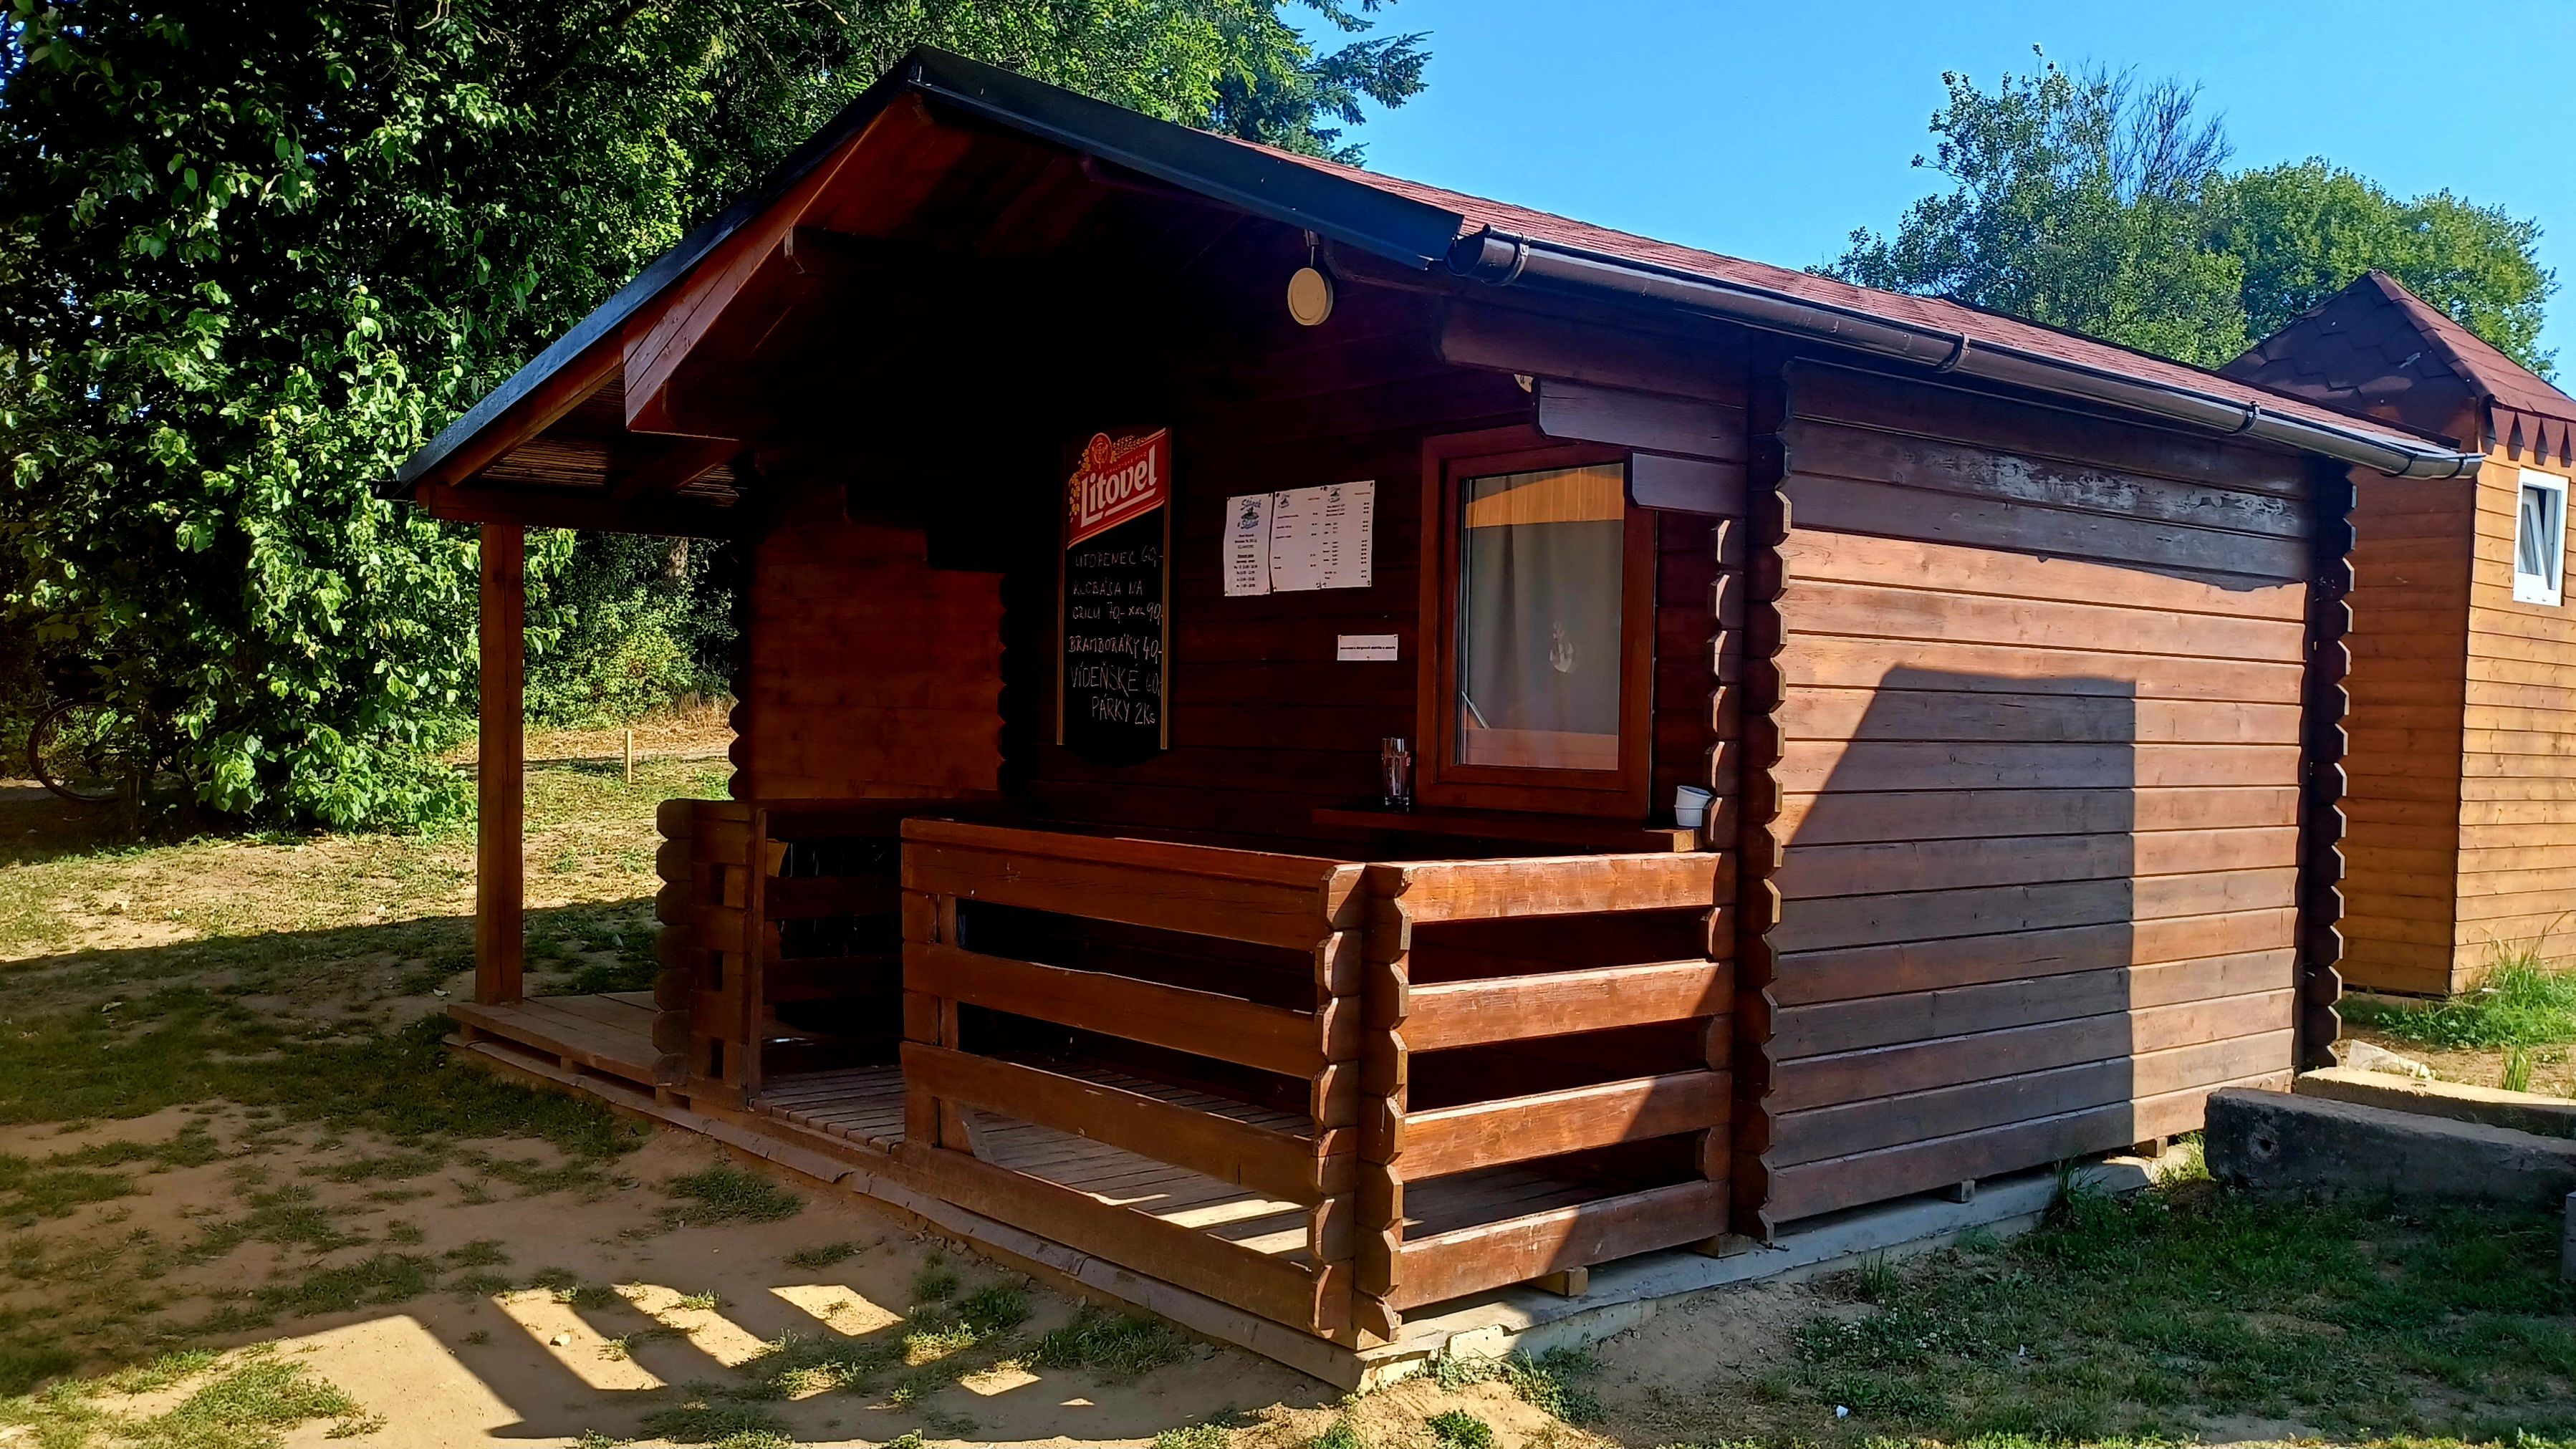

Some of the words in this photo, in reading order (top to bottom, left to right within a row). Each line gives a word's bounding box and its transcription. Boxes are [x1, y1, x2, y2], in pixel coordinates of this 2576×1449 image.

[1080, 444, 1158, 529] Litovel
[1075, 551, 1136, 568] UTOPENEC
[1128, 579, 1143, 596] NA
[1072, 606, 1101, 620] GRILU
[1068, 633, 1140, 659] BRAMBORÁKY
[1070, 660, 1139, 698] VÍDEŇSKÉ
[1092, 693, 1130, 723] PÁRKY
